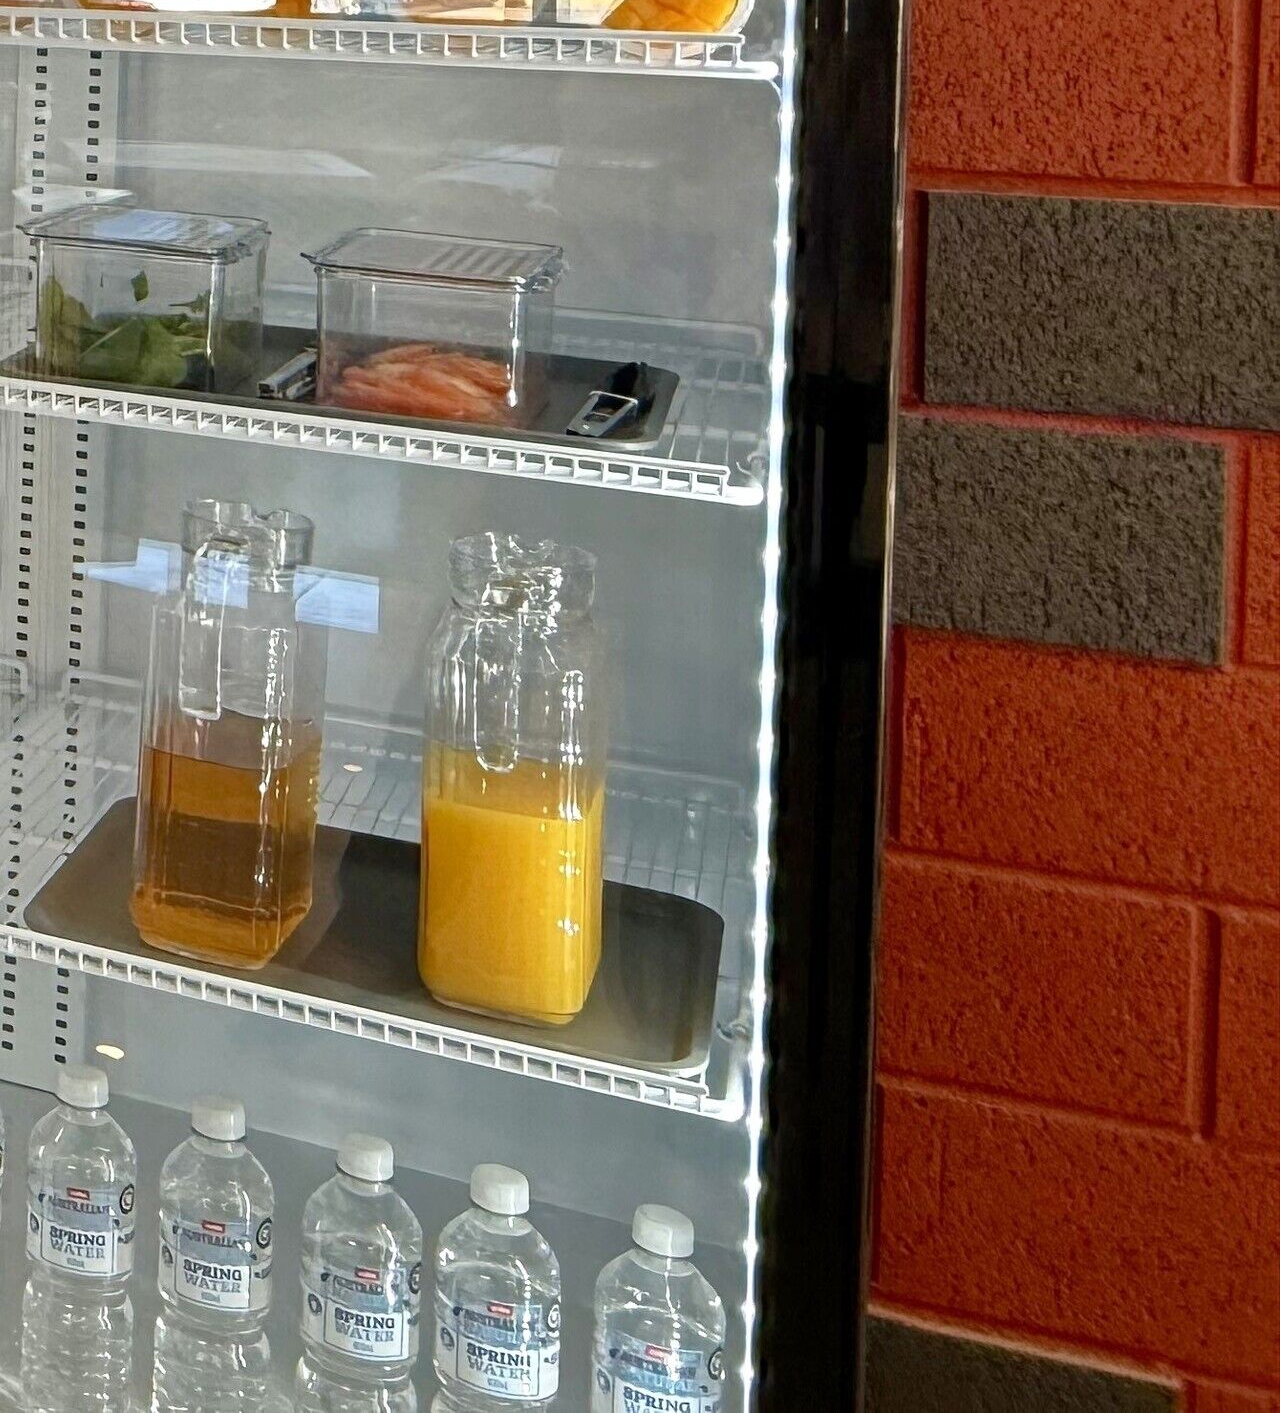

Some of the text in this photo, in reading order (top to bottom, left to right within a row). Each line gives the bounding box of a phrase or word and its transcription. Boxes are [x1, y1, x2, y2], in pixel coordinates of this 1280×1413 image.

[50, 1225, 106, 1247] SPRING
[51, 1236, 106, 1259] WATER
[183, 1258, 243, 1282] SPRING
[184, 1270, 242, 1293] WATER
[335, 1306, 395, 1329] SPRING
[335, 1318, 395, 1342] WATER
[466, 1355, 532, 1382] WATER
[623, 1385, 691, 1413] SPRING
